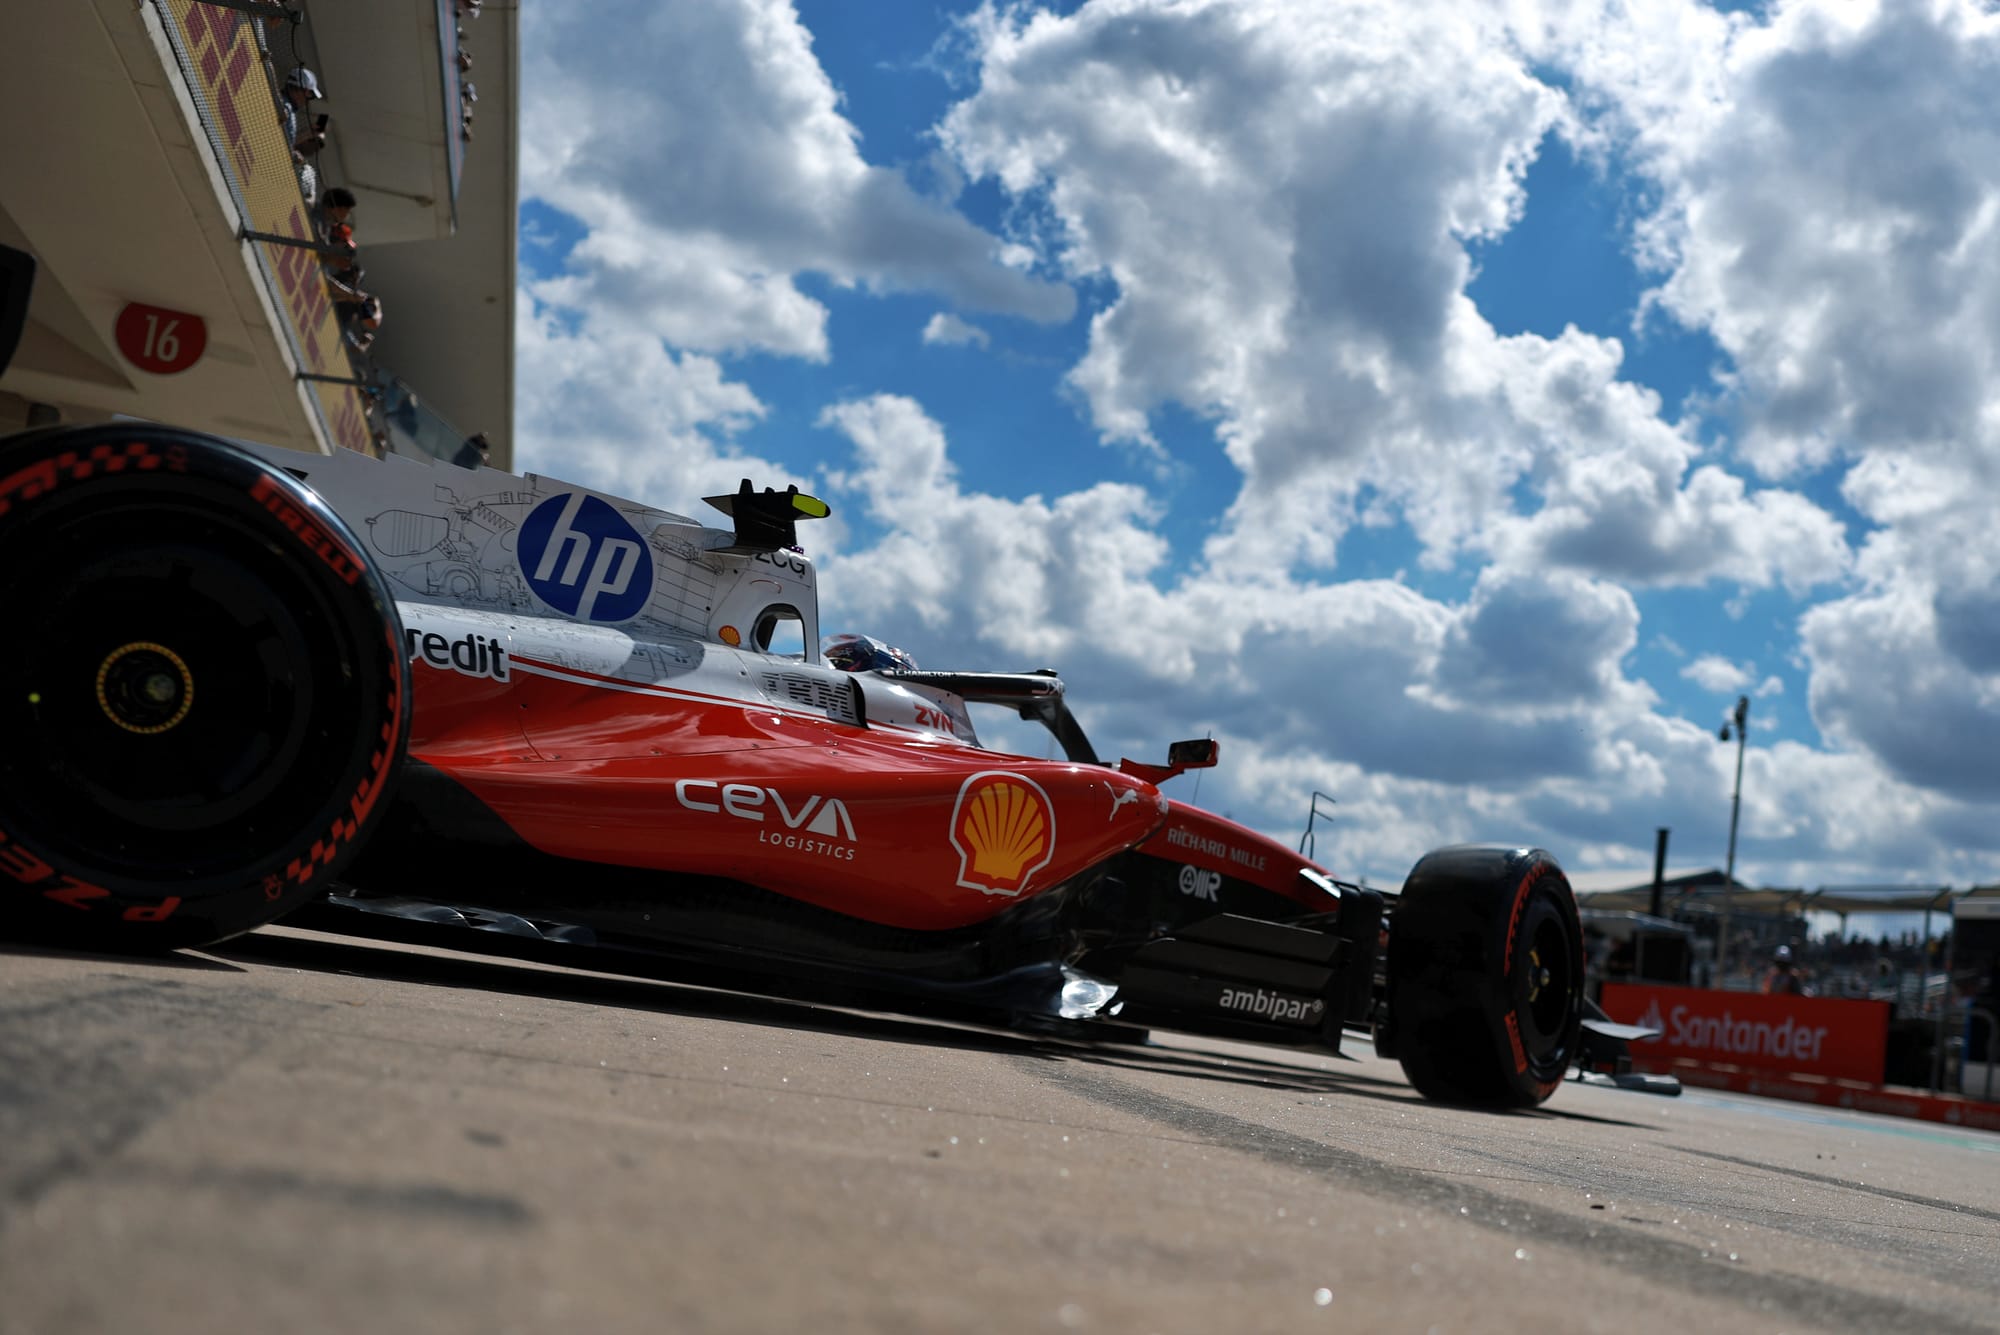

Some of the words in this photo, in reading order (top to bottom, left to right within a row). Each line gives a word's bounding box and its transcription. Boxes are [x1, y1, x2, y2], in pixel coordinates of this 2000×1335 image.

[143, 313, 180, 362] 16
[533, 493, 642, 621] hp
[761, 671, 853, 719] IBM
[914, 704, 954, 734] ZYN
[758, 829, 855, 861] LOGISTICS
[1168, 828, 1227, 858] RICHARD
[1230, 847, 1266, 871] MILLE
[0, 828, 112, 911] ZE
[1668, 1004, 1828, 1061] Santander
